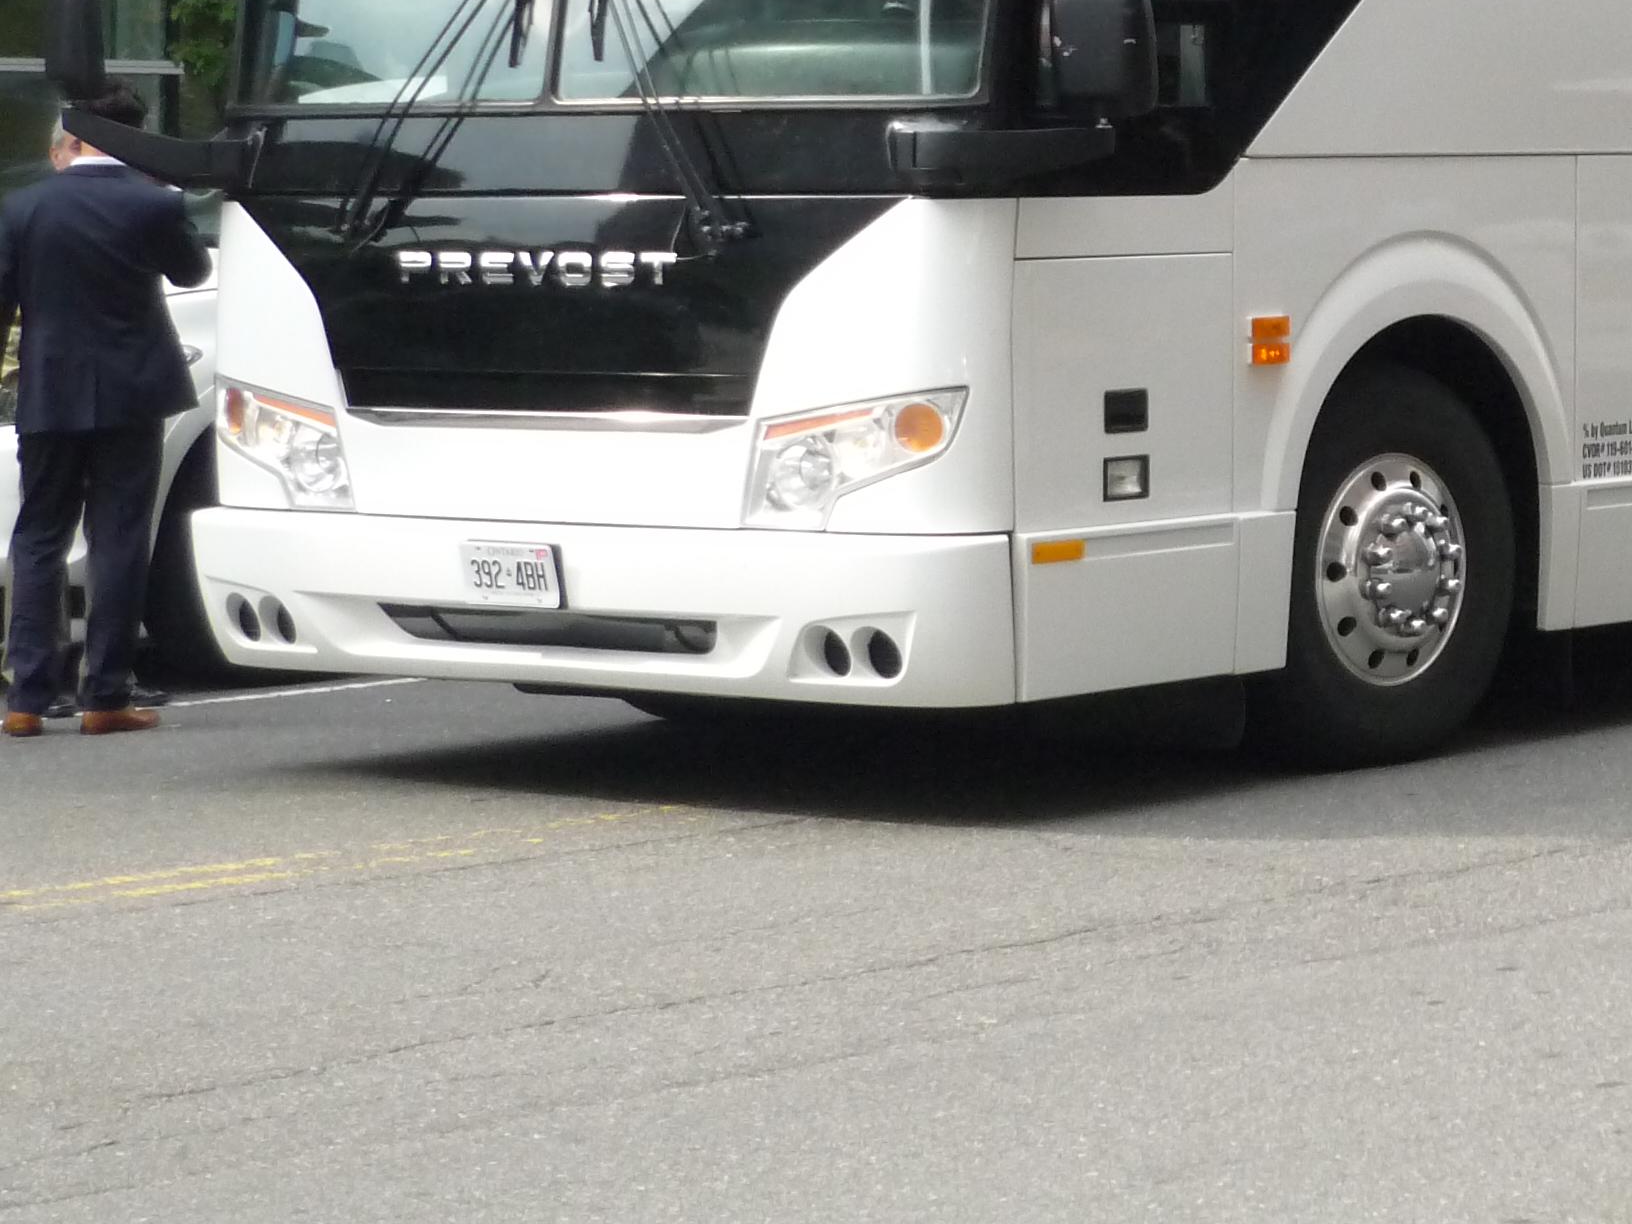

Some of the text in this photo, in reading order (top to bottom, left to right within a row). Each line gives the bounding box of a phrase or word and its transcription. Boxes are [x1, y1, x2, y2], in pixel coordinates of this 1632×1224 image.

[398, 250, 678, 287] PREVOST
[1591, 422, 1599, 440] by
[1600, 421, 1627, 437] Quantum
[1582, 462, 1592, 479] US
[470, 559, 549, 591] 392 4BH
